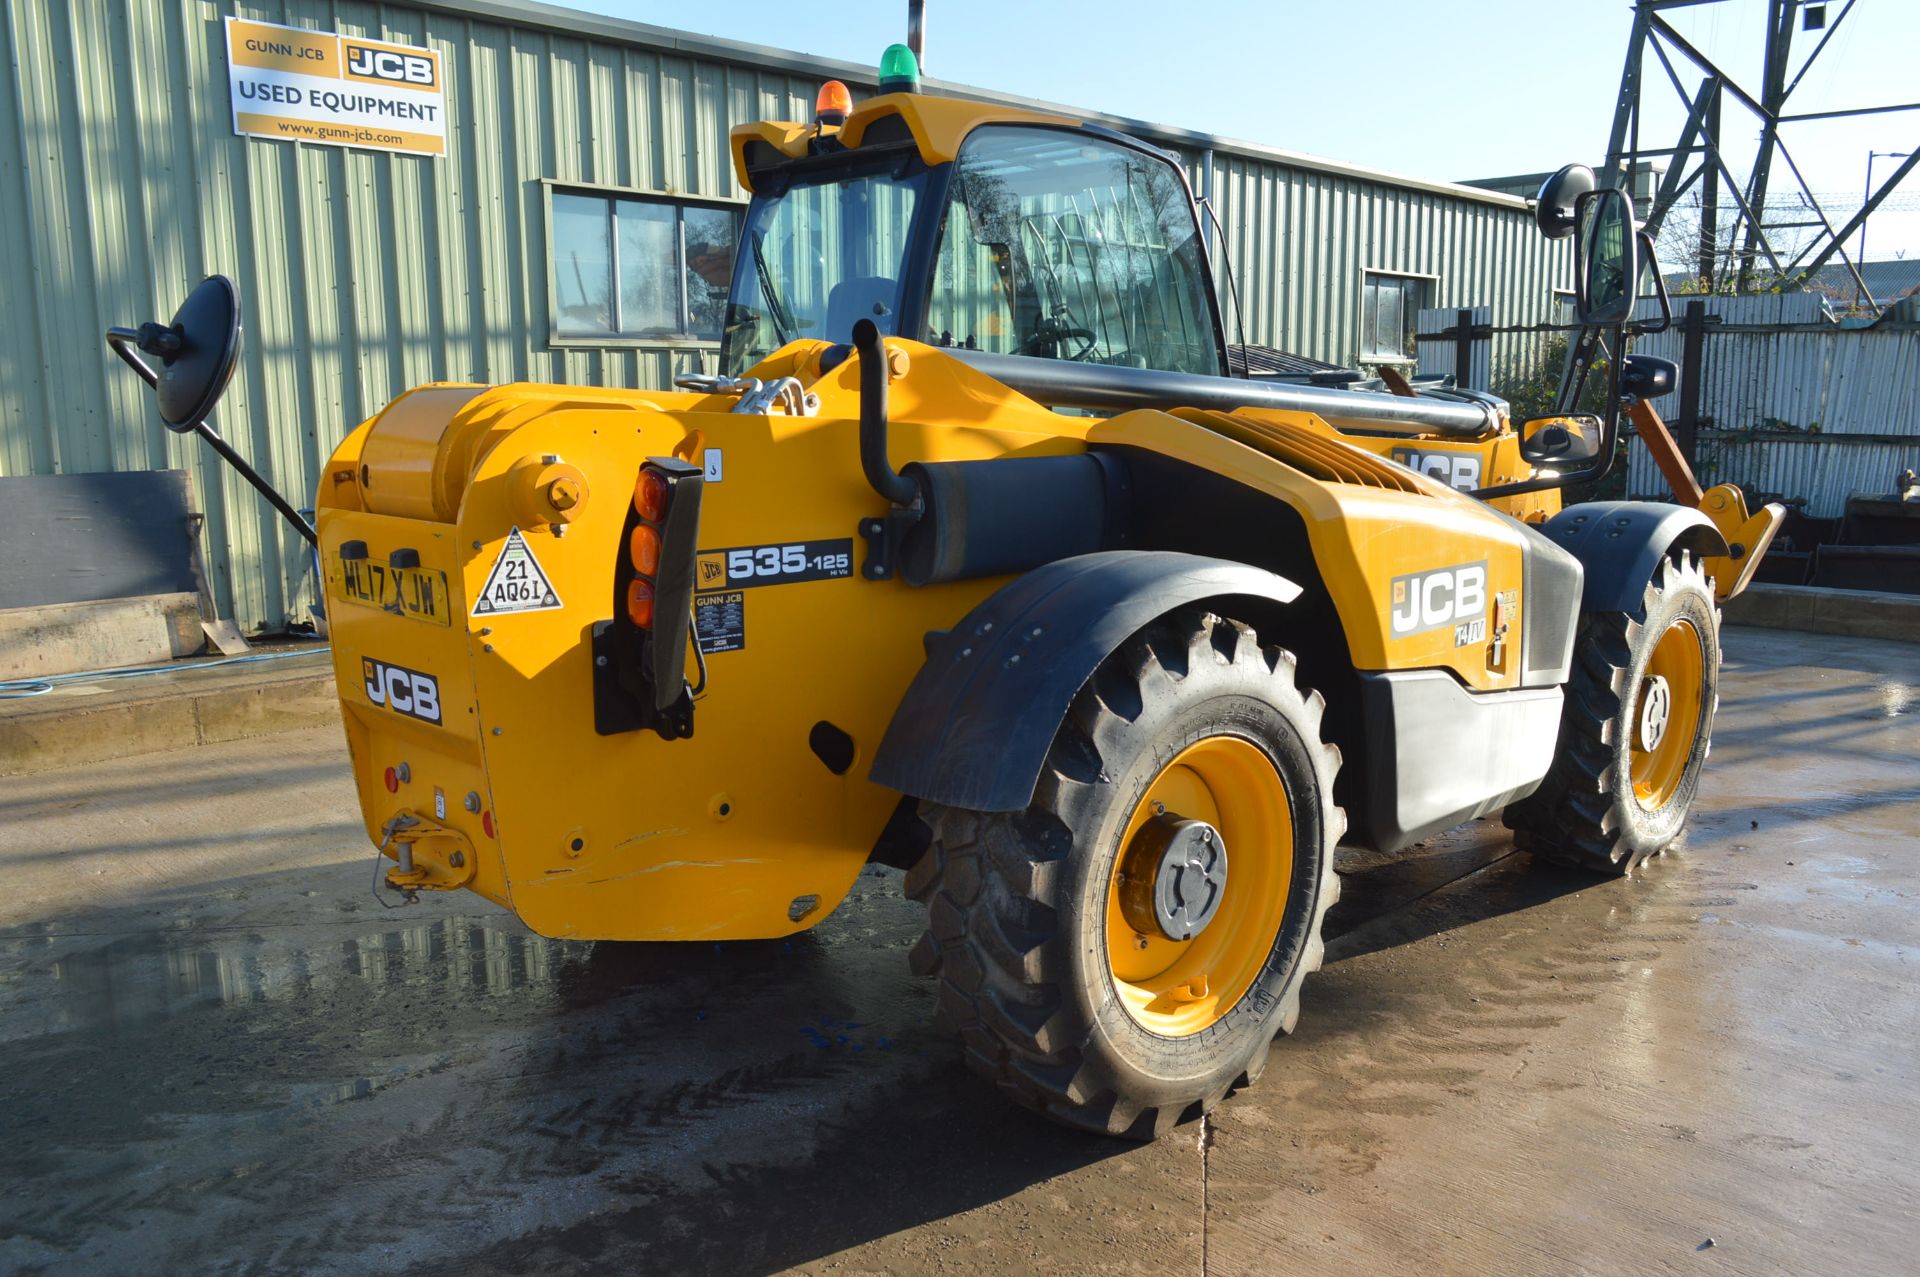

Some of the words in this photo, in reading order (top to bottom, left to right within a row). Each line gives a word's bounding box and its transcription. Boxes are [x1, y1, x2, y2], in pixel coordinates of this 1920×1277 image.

[245, 39, 293, 57] GUNN
[296, 46, 325, 61] JCB
[349, 49, 433, 84] JCB
[239, 80, 302, 105] USED
[309, 90, 438, 122] EQUIPMENT
[277, 122, 403, 145] www.gunn-jcb.com
[343, 559, 385, 604] ML17
[390, 568, 435, 616] XJW
[505, 560, 528, 580] 21
[697, 595, 724, 606] GUNN
[725, 594, 742, 604] JCB
[1392, 566, 1486, 633] JCB
[366, 663, 440, 721] JCB
